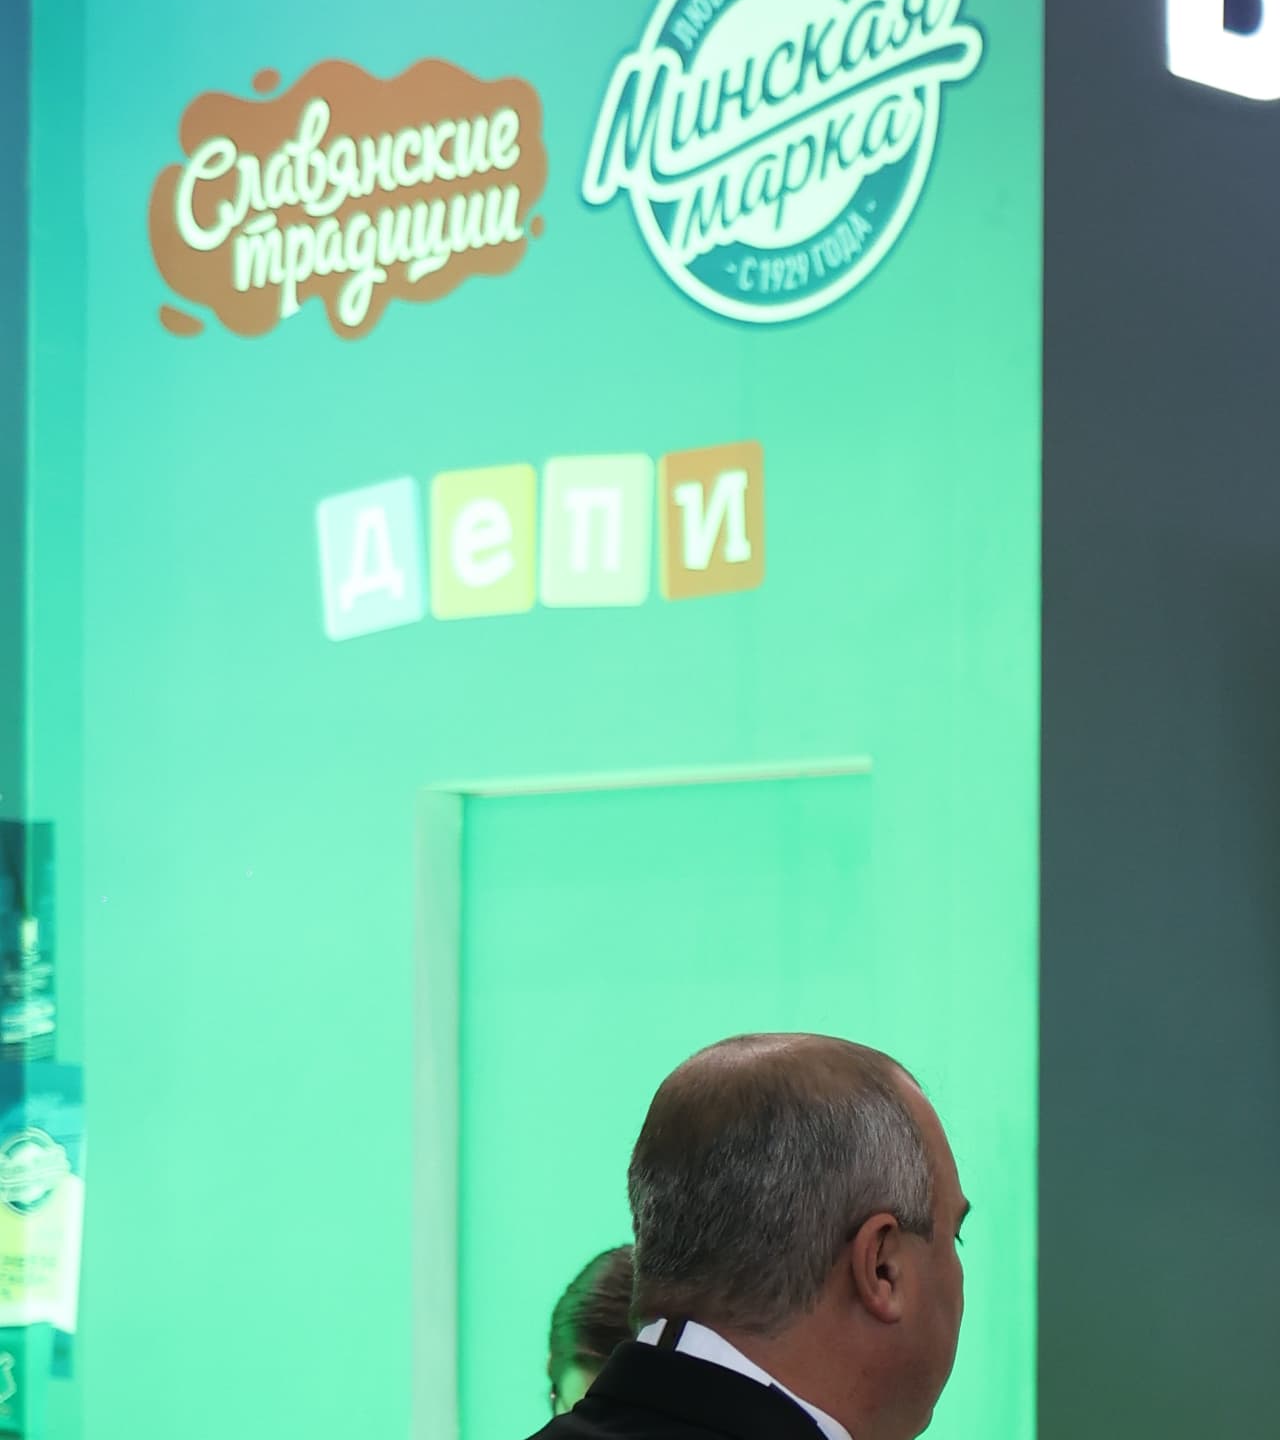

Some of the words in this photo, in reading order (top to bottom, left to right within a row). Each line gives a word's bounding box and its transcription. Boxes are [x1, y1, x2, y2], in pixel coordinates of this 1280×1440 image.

[175, 96, 521, 251] Славянские
[680, 93, 914, 251] марка
[233, 183, 524, 327] традиции
[760, 256, 809, 293] 1929
[812, 212, 873, 278] ГОДА
